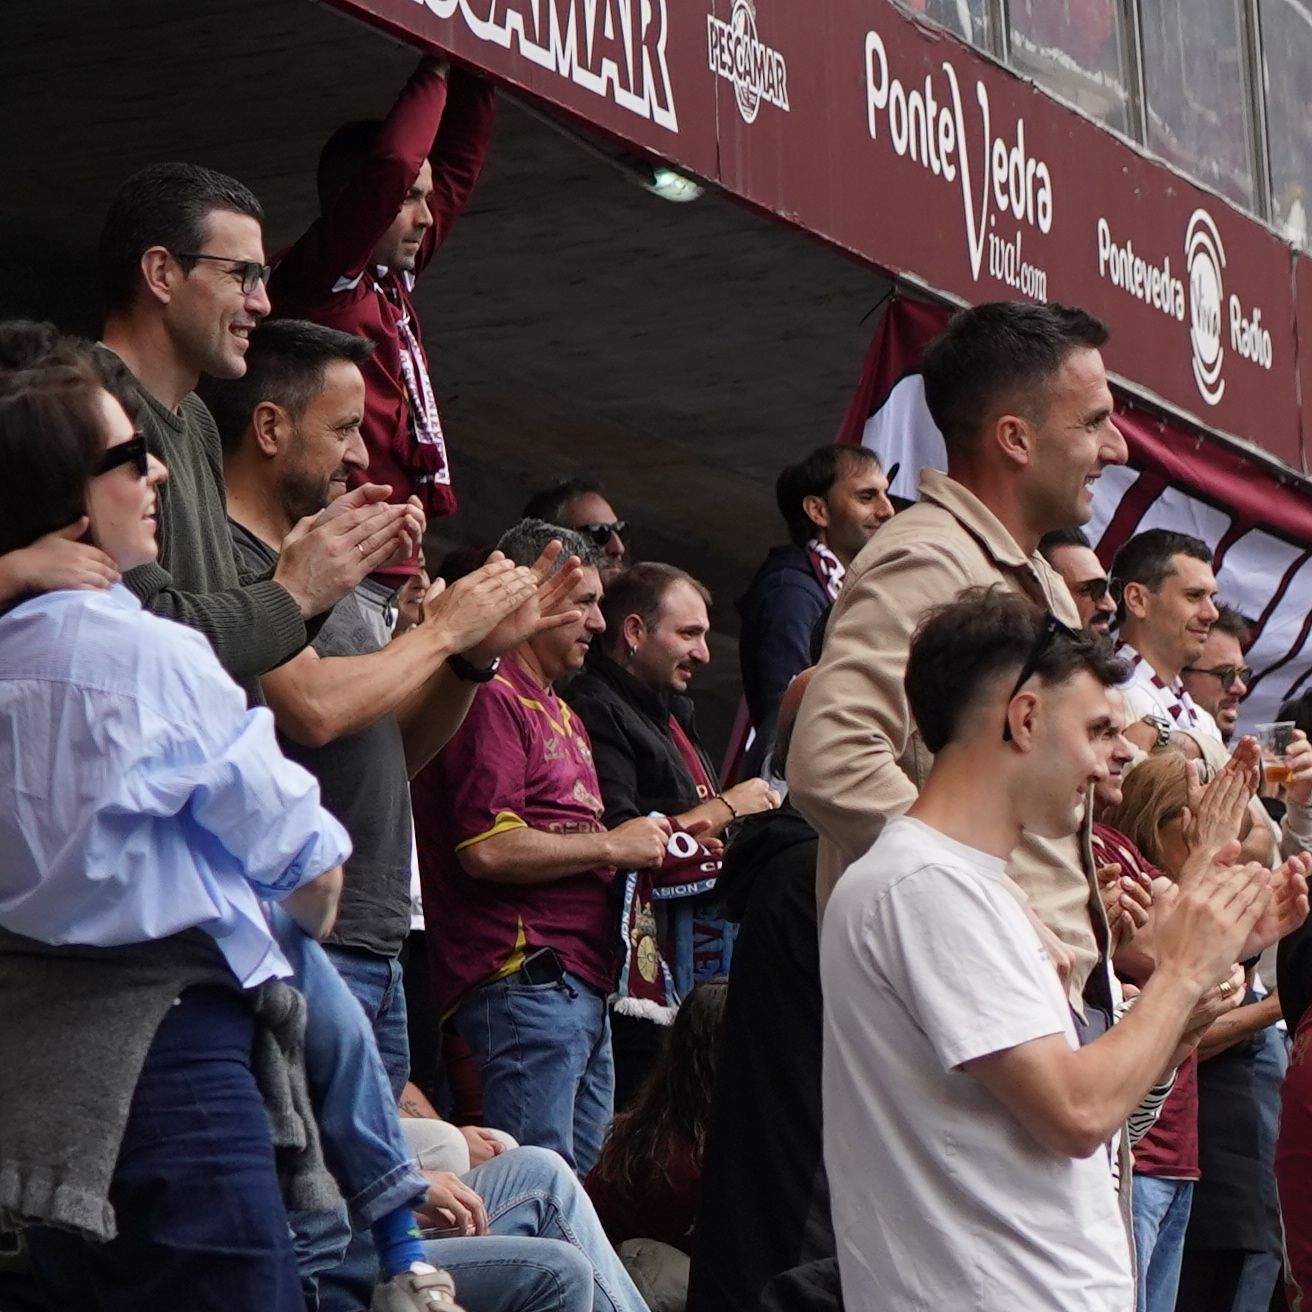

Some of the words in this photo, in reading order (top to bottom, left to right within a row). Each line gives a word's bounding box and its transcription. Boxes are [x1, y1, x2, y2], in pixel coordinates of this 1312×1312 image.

[707, 13, 790, 112] PESCAMAR
[1097, 217, 1185, 322] Pontevedra
[1229, 293, 1272, 370] Radio
